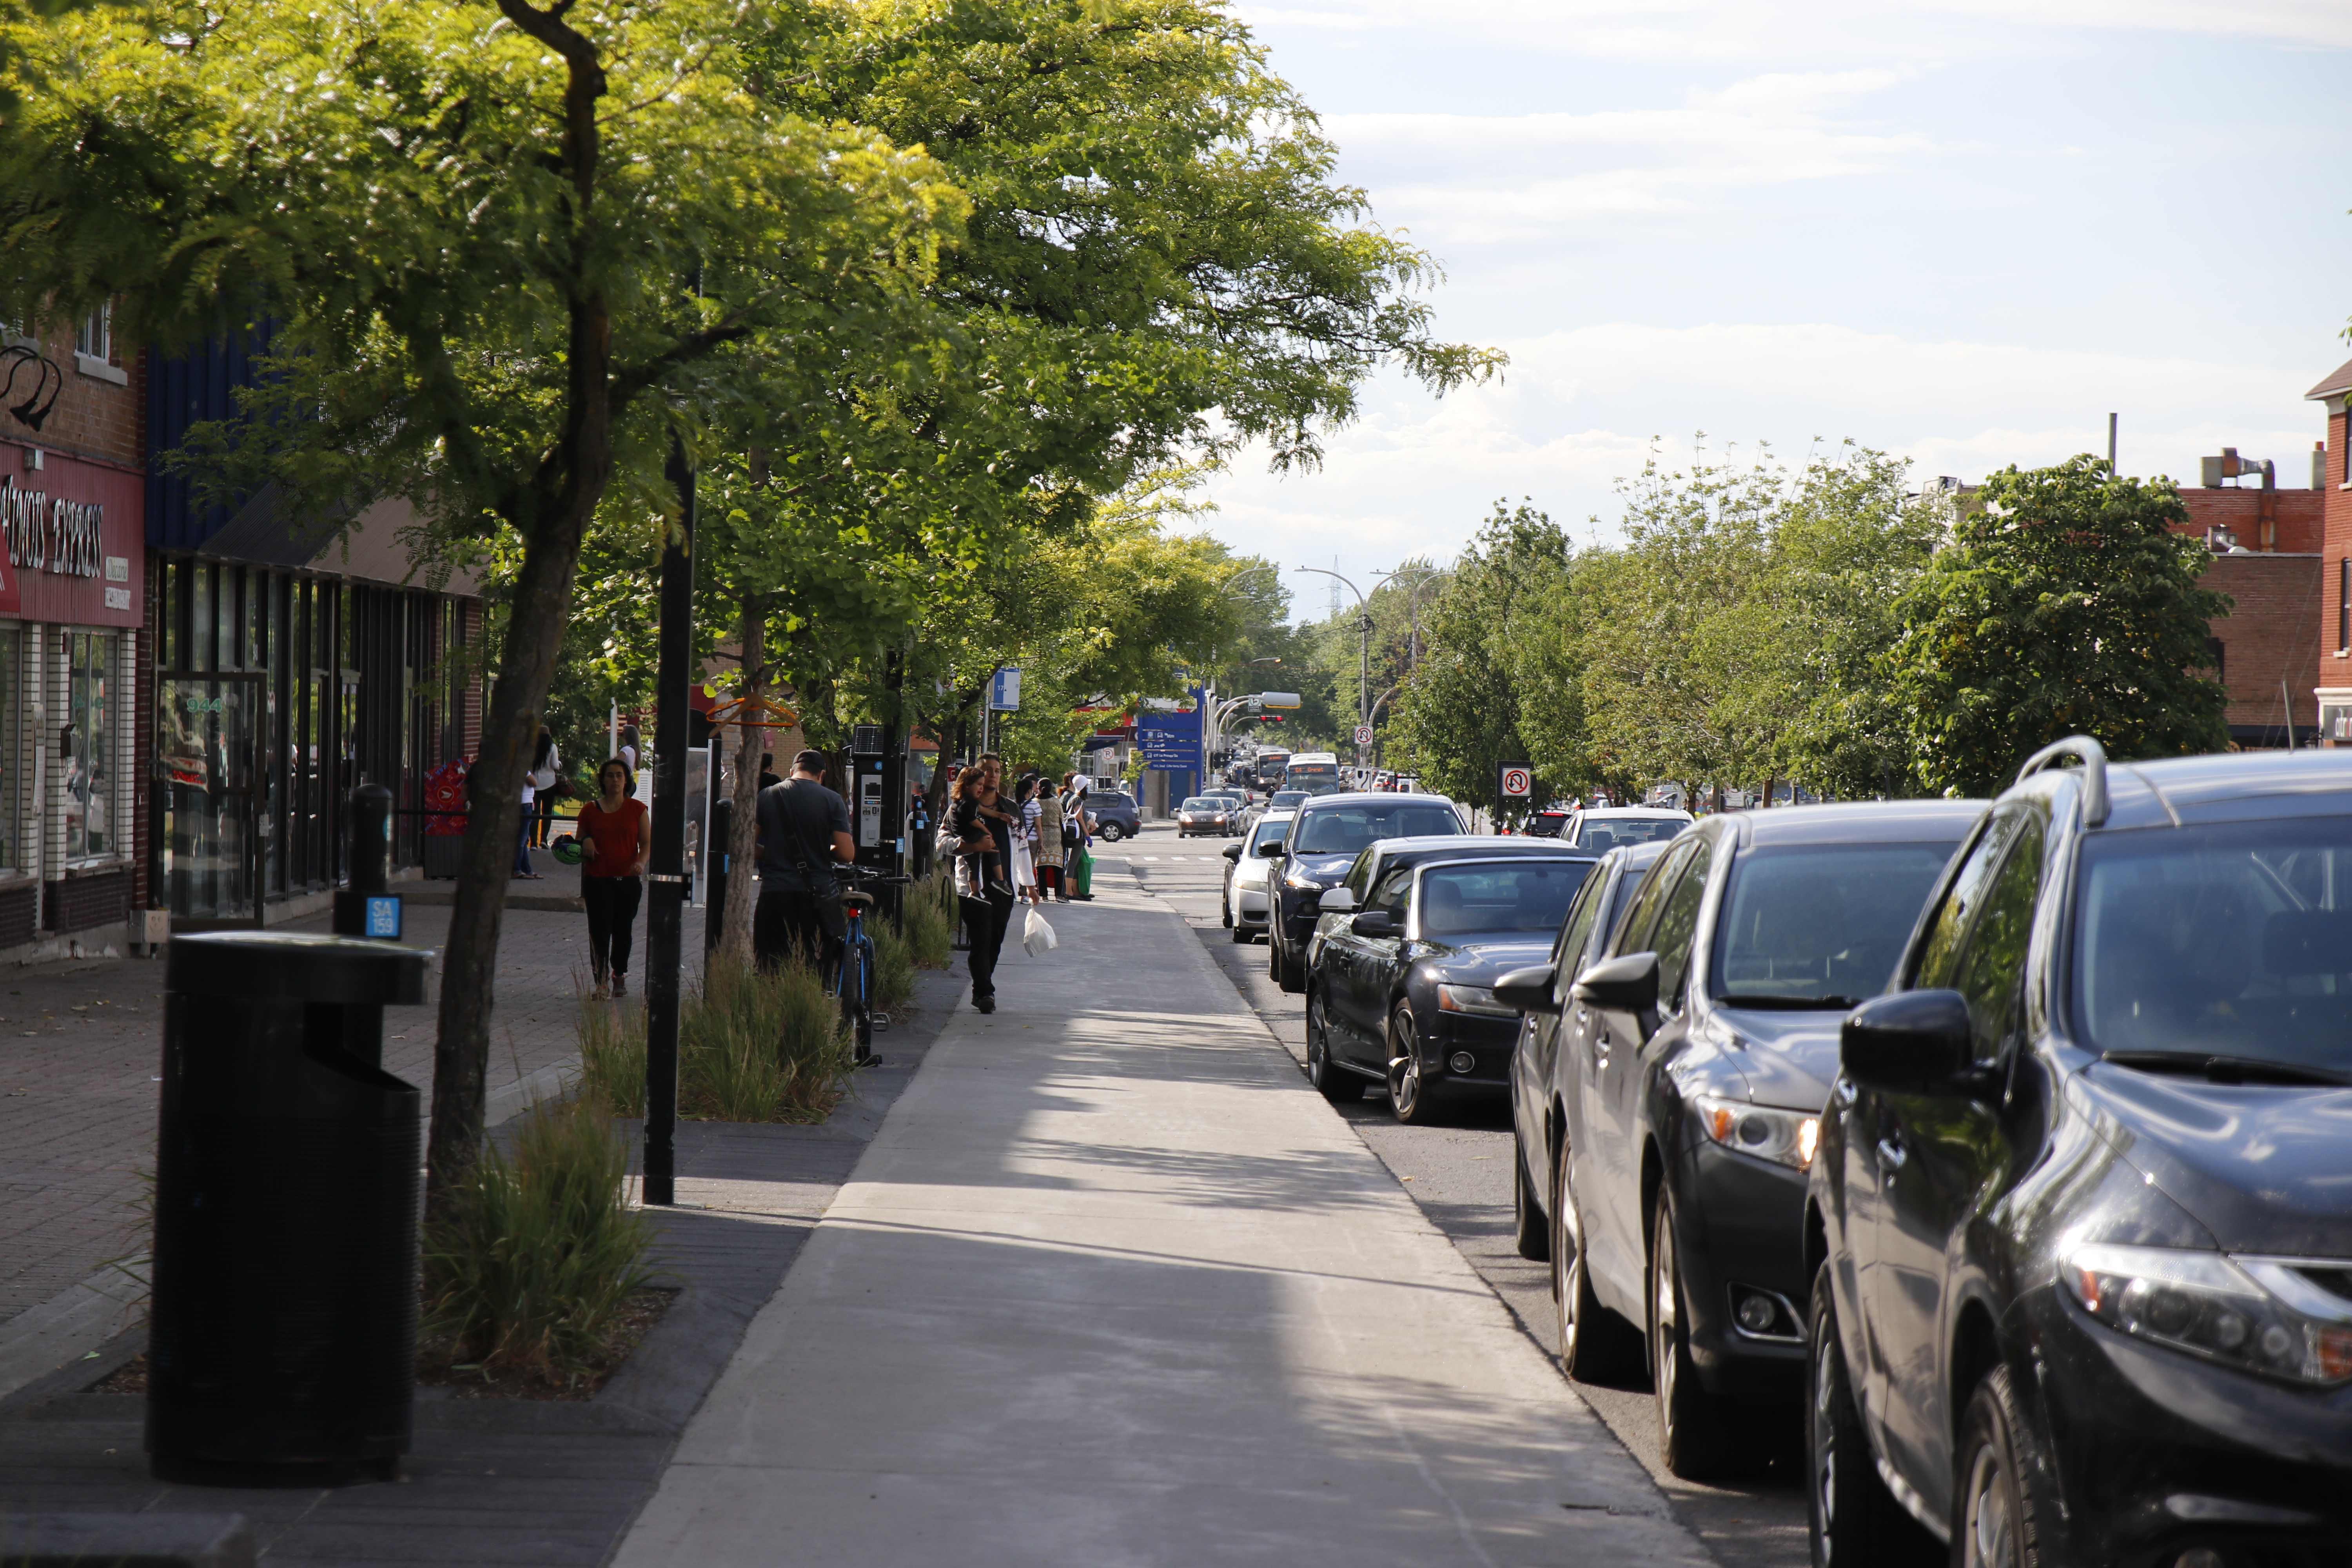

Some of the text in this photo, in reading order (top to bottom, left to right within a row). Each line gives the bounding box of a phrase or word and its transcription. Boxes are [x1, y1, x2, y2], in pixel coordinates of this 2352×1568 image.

[0, 474, 102, 578] HINOIS EXPRESS
[187, 698, 222, 713] 944
[372, 901, 392, 917] SA
[374, 918, 394, 933] 159
